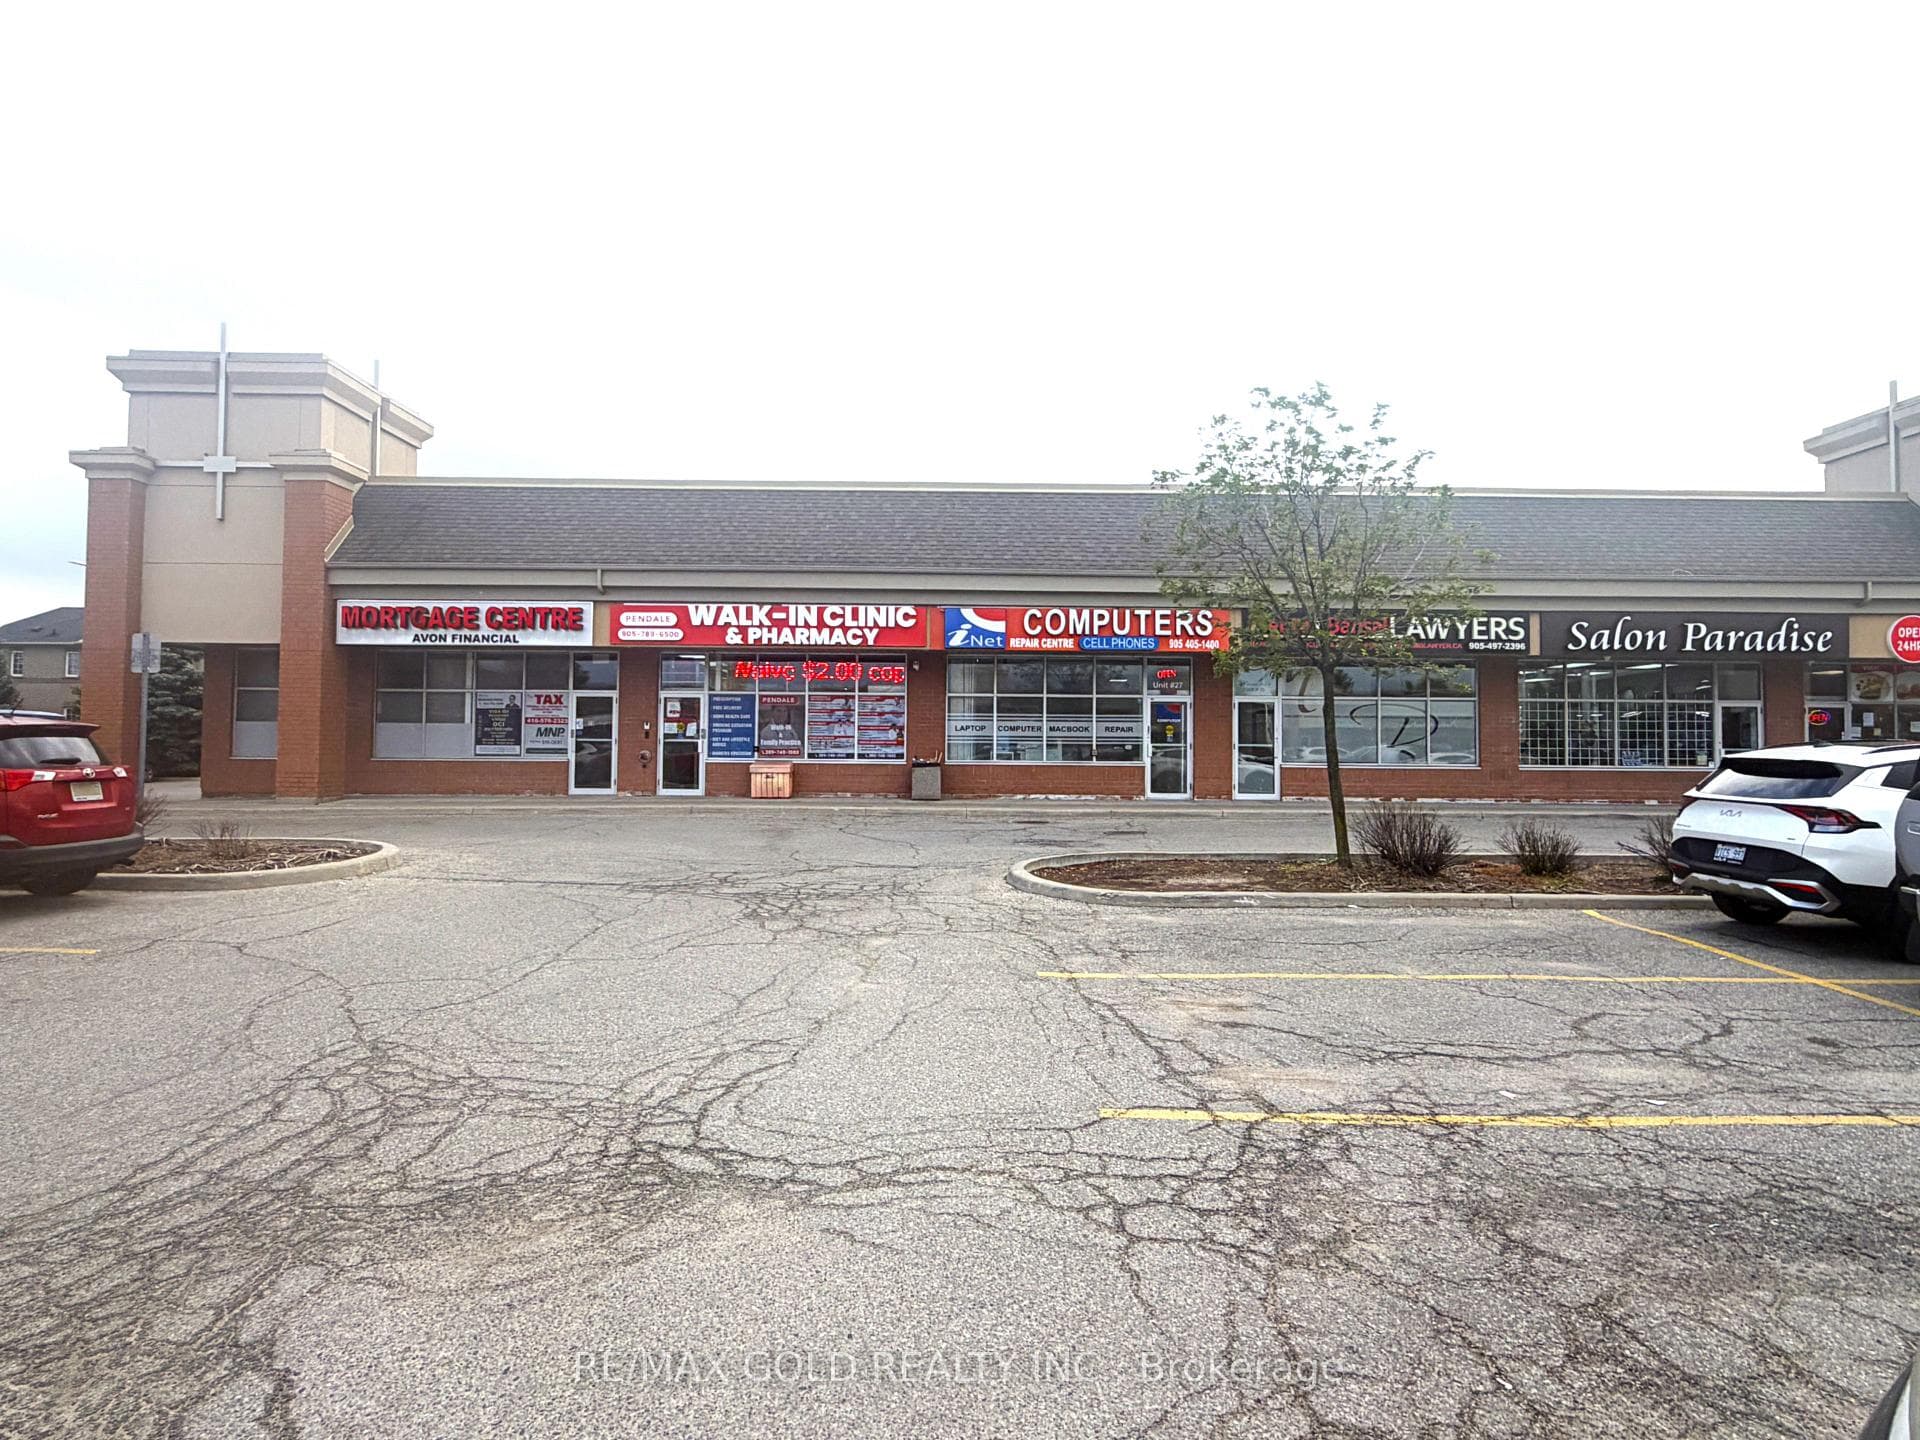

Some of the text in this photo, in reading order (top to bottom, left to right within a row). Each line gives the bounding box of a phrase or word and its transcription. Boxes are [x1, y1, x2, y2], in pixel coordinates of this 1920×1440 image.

[341, 606, 584, 631] MORTGAGE CENTRE
[626, 615, 671, 623] PENDALE
[688, 604, 917, 628] WALK-IN CLINIC
[1023, 608, 1213, 636] COMPUTERS
[1390, 616, 1526, 641] LAWYERS
[1567, 616, 1833, 652] Salon Paradise
[1898, 627, 1920, 638] OPE
[412, 634, 519, 643] AVON FINANCIAL
[725, 627, 879, 645] & PHARMACY
[1010, 638, 1074, 649] REPAIR CENTRE
[1083, 638, 1155, 649] CELL PHONES
[1169, 639, 1219, 649] 905 405-1400
[1468, 642, 1526, 650] 905-497-2396
[801, 660, 863, 681] $2.00
[1152, 681, 1168, 689] Unit
[534, 694, 564, 705] TAX
[536, 727, 565, 737] MNP
[954, 724, 986, 732] LAPTOP
[998, 725, 1042, 733] COMPUTER
[1049, 725, 1090, 733] MACBOOK
[1104, 725, 1134, 733] REPAIR
